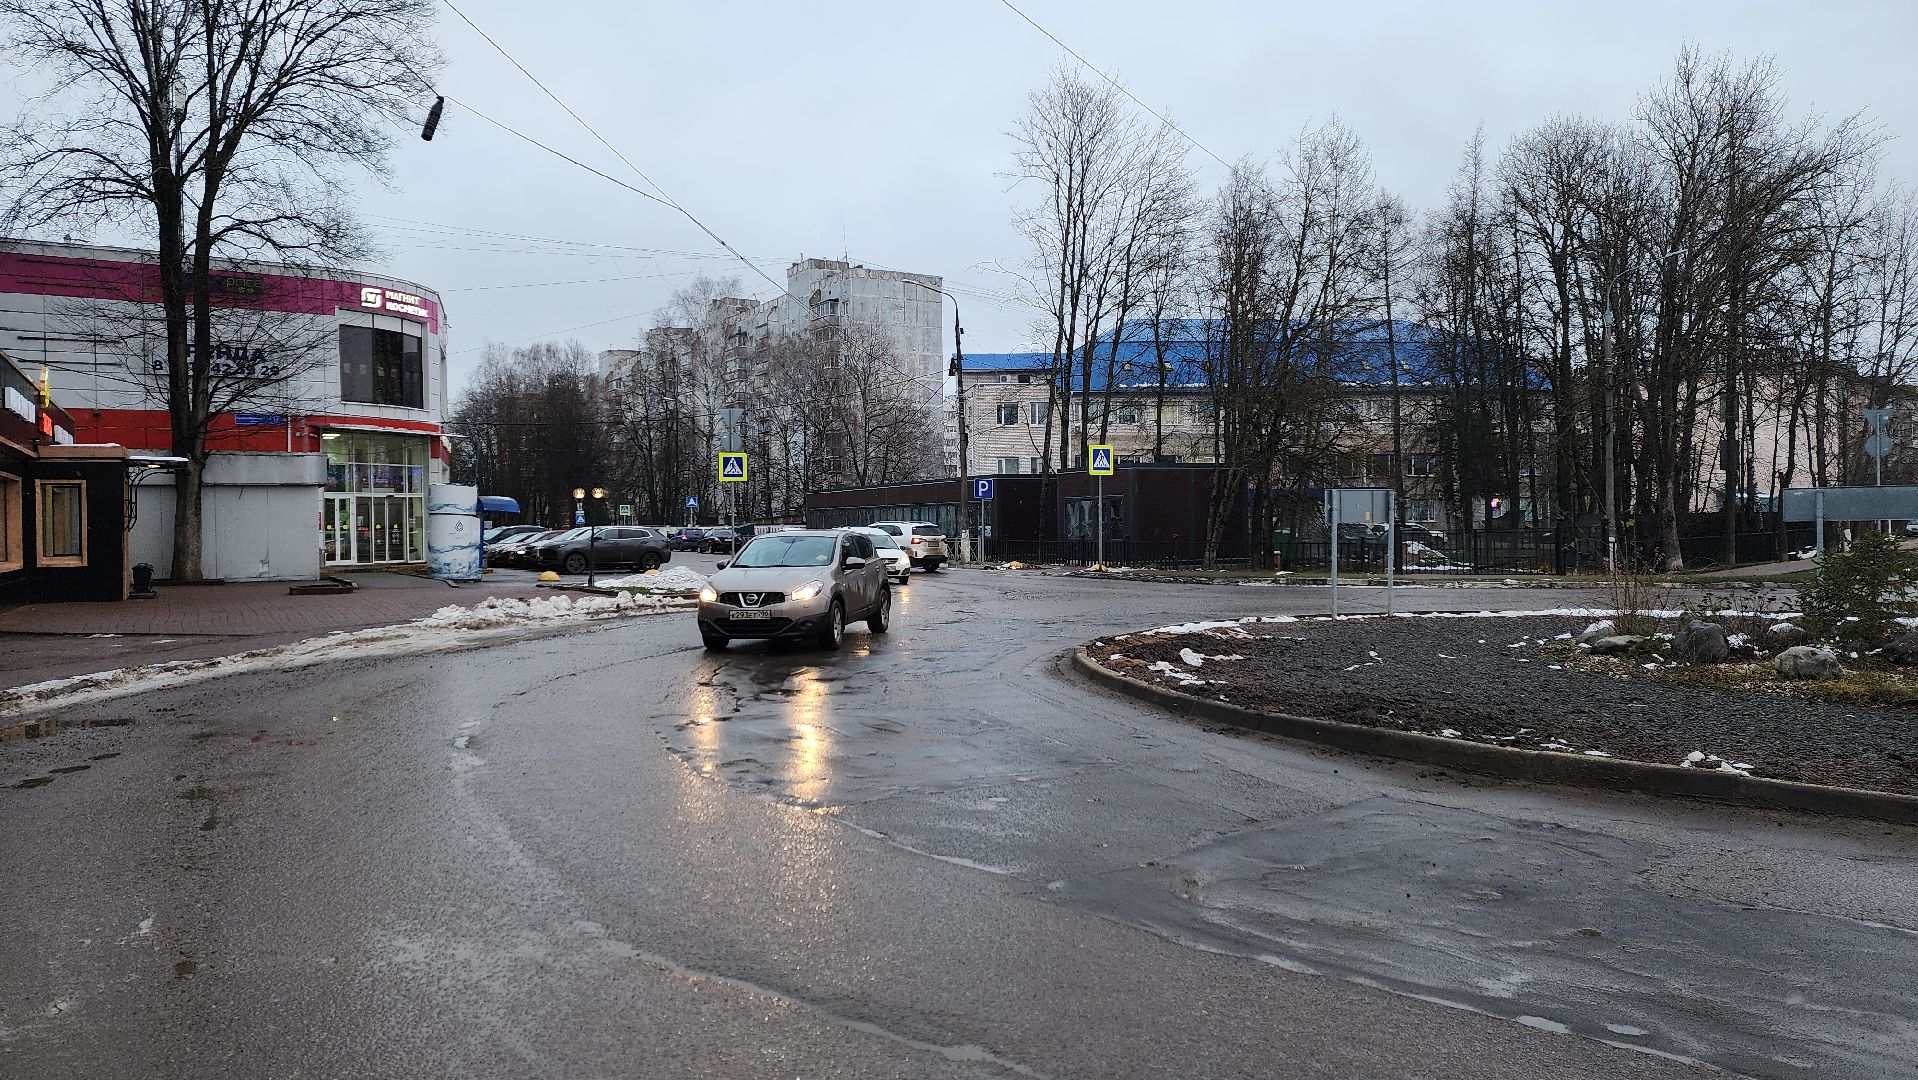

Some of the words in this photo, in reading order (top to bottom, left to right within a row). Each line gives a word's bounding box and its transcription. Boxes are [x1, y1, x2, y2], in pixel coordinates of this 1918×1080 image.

[385, 290, 421, 305] МАГНИТ
[385, 301, 428, 318] КОСМЕТИК
[978, 480, 989, 497] P
